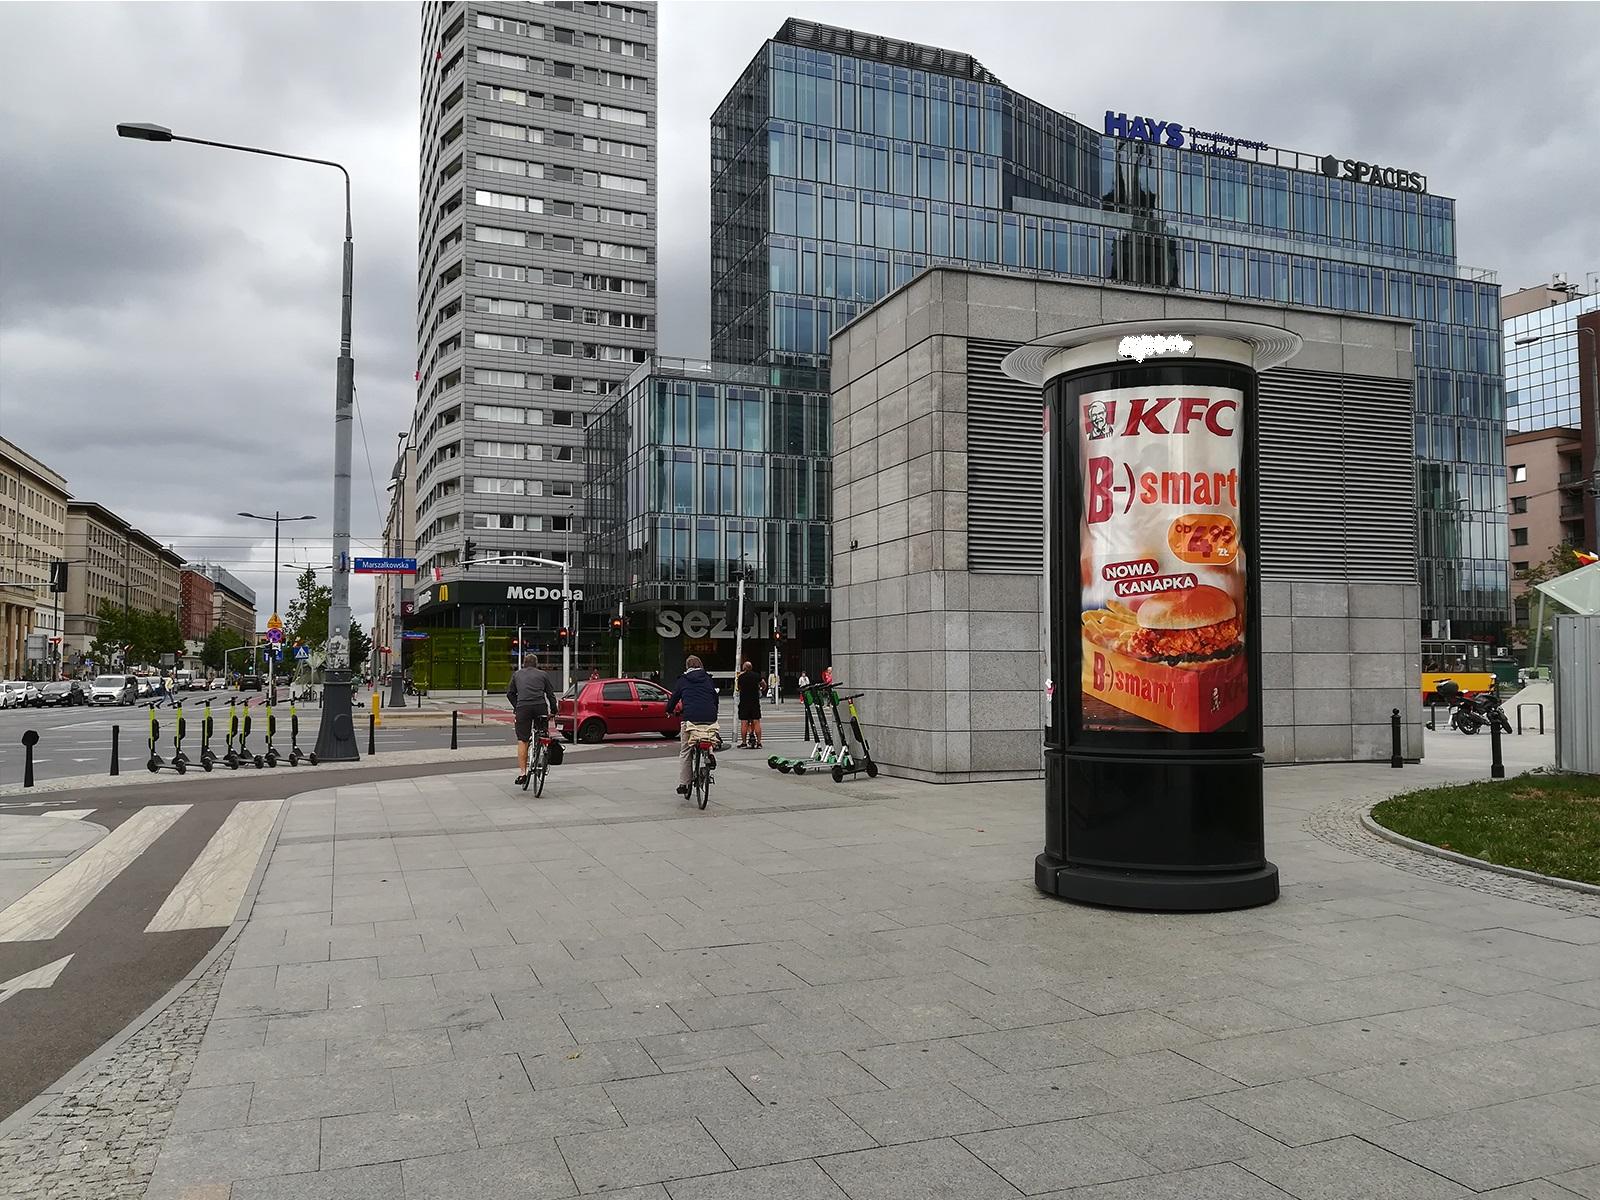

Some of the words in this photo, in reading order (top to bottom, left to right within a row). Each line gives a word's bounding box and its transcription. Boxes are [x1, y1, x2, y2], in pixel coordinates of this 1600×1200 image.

[1105, 111, 1185, 149] HAYS
[1189, 127, 1236, 146] Recruiting
[1236, 138, 1269, 151] experts
[1189, 142, 1237, 158] worldwide
[1343, 159, 1422, 192] SPACES
[1120, 398, 1236, 436] KFC
[1175, 524, 1192, 533] OD
[1105, 562, 1155, 579] NOWA
[1118, 576, 1195, 595] KANAPKA
